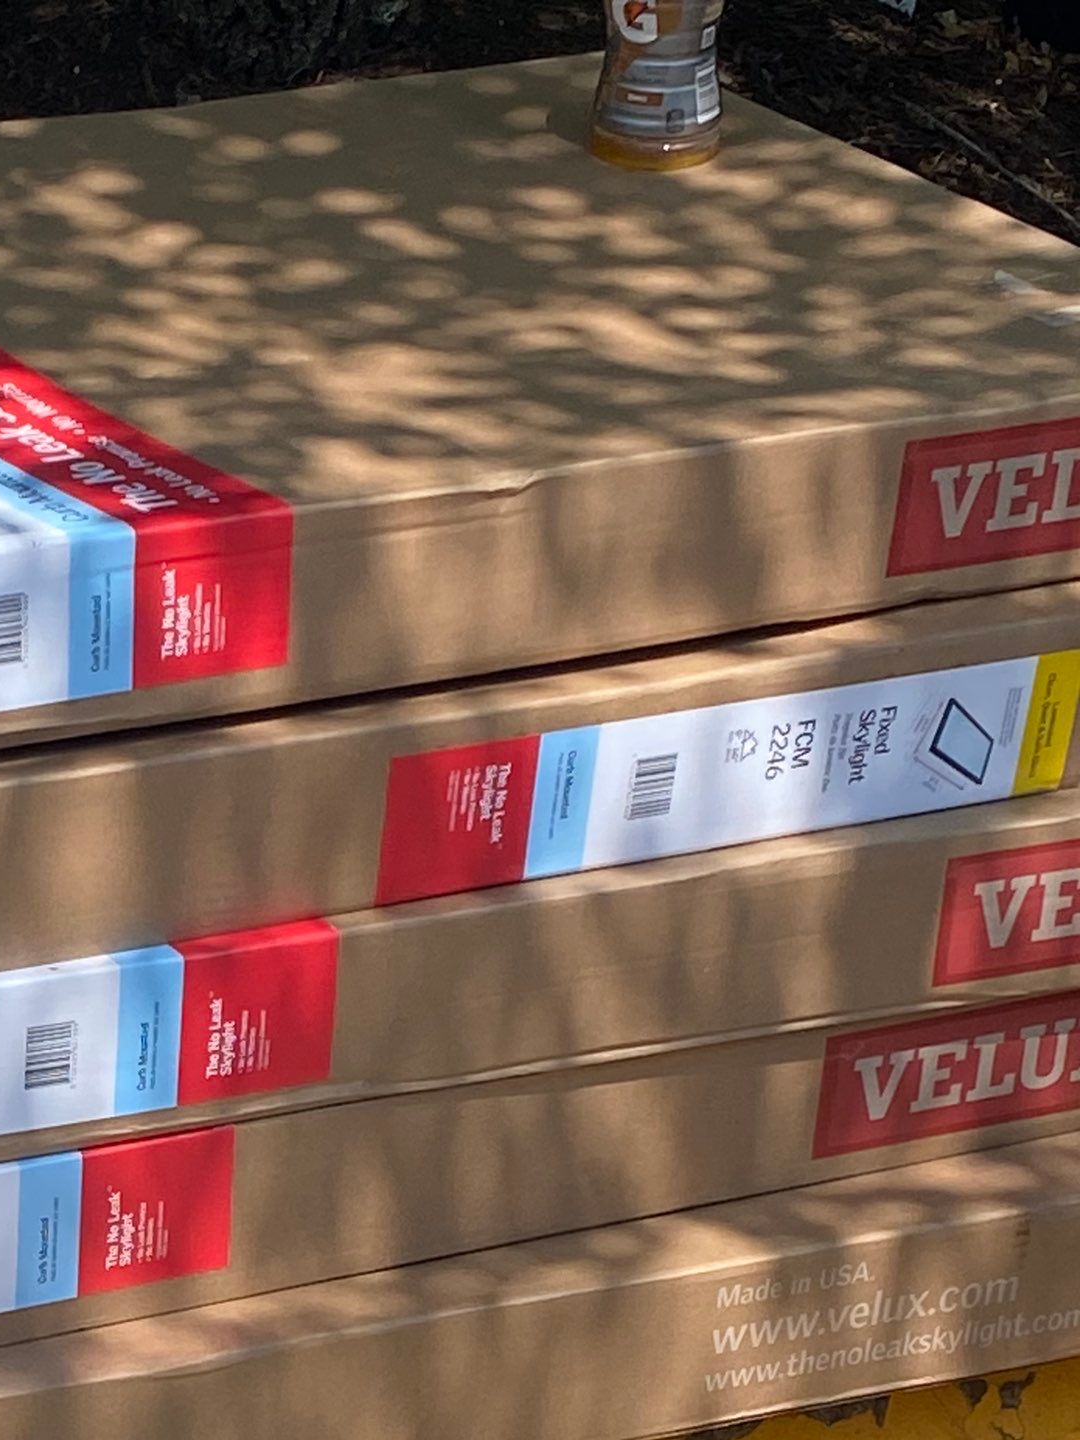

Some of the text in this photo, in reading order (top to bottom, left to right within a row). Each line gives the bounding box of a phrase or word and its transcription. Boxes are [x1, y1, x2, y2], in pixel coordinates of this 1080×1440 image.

[70, 461, 126, 485] No
[113, 482, 178, 512] The
[930, 447, 1080, 541] VEL
[160, 568, 177, 661] The No Leak
[175, 593, 191, 657] Skylight
[765, 722, 791, 781] 2246
[791, 718, 817, 770] FCM
[848, 709, 877, 785] Skylight
[873, 705, 898, 755] Fixed
[478, 763, 498, 821] Skylight
[490, 762, 512, 844] The No Leak
[205, 998, 223, 1080] The No Leak
[219, 1020, 237, 1077] Skylight
[853, 1017, 1080, 1122] VELU
[104, 1191, 121, 1271] The No Leak
[119, 1212, 136, 1267] Skylight
[711, 1275, 1019, 1355] www.velux.com
[716, 1260, 876, 1310] Made in USA.
[704, 1307, 1080, 1393] www.thenoleakskylight.com
